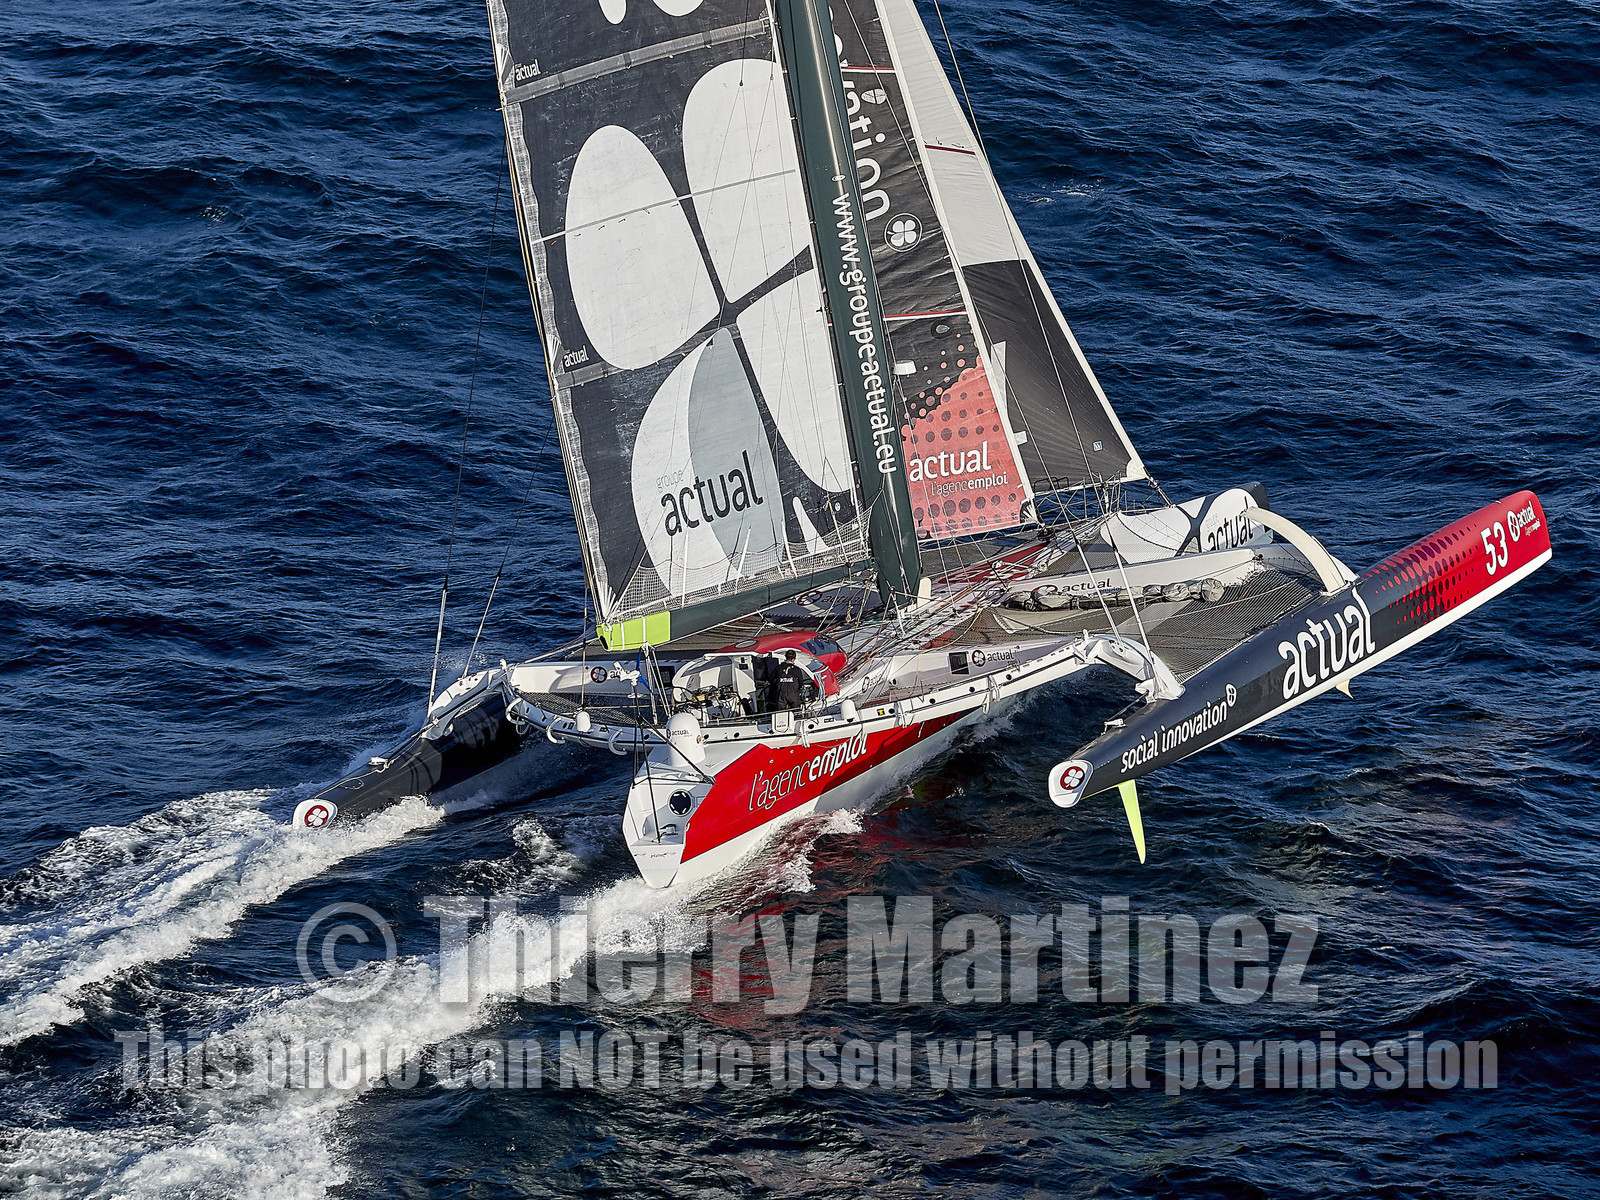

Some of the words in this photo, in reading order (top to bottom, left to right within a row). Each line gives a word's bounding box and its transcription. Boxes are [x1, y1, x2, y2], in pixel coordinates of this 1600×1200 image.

[515, 58, 541, 81] actual
[563, 345, 589, 368] actual
[832, 192, 897, 474] www.groupeactual.eu
[909, 440, 992, 482] actual
[661, 450, 763, 536] actual
[1480, 521, 1508, 575] 53
[1061, 578, 1112, 593] actual
[987, 649, 1014, 662] actual
[1278, 587, 1376, 700] actual
[1120, 734, 1159, 773] social
[1162, 702, 1227, 752] innovation
